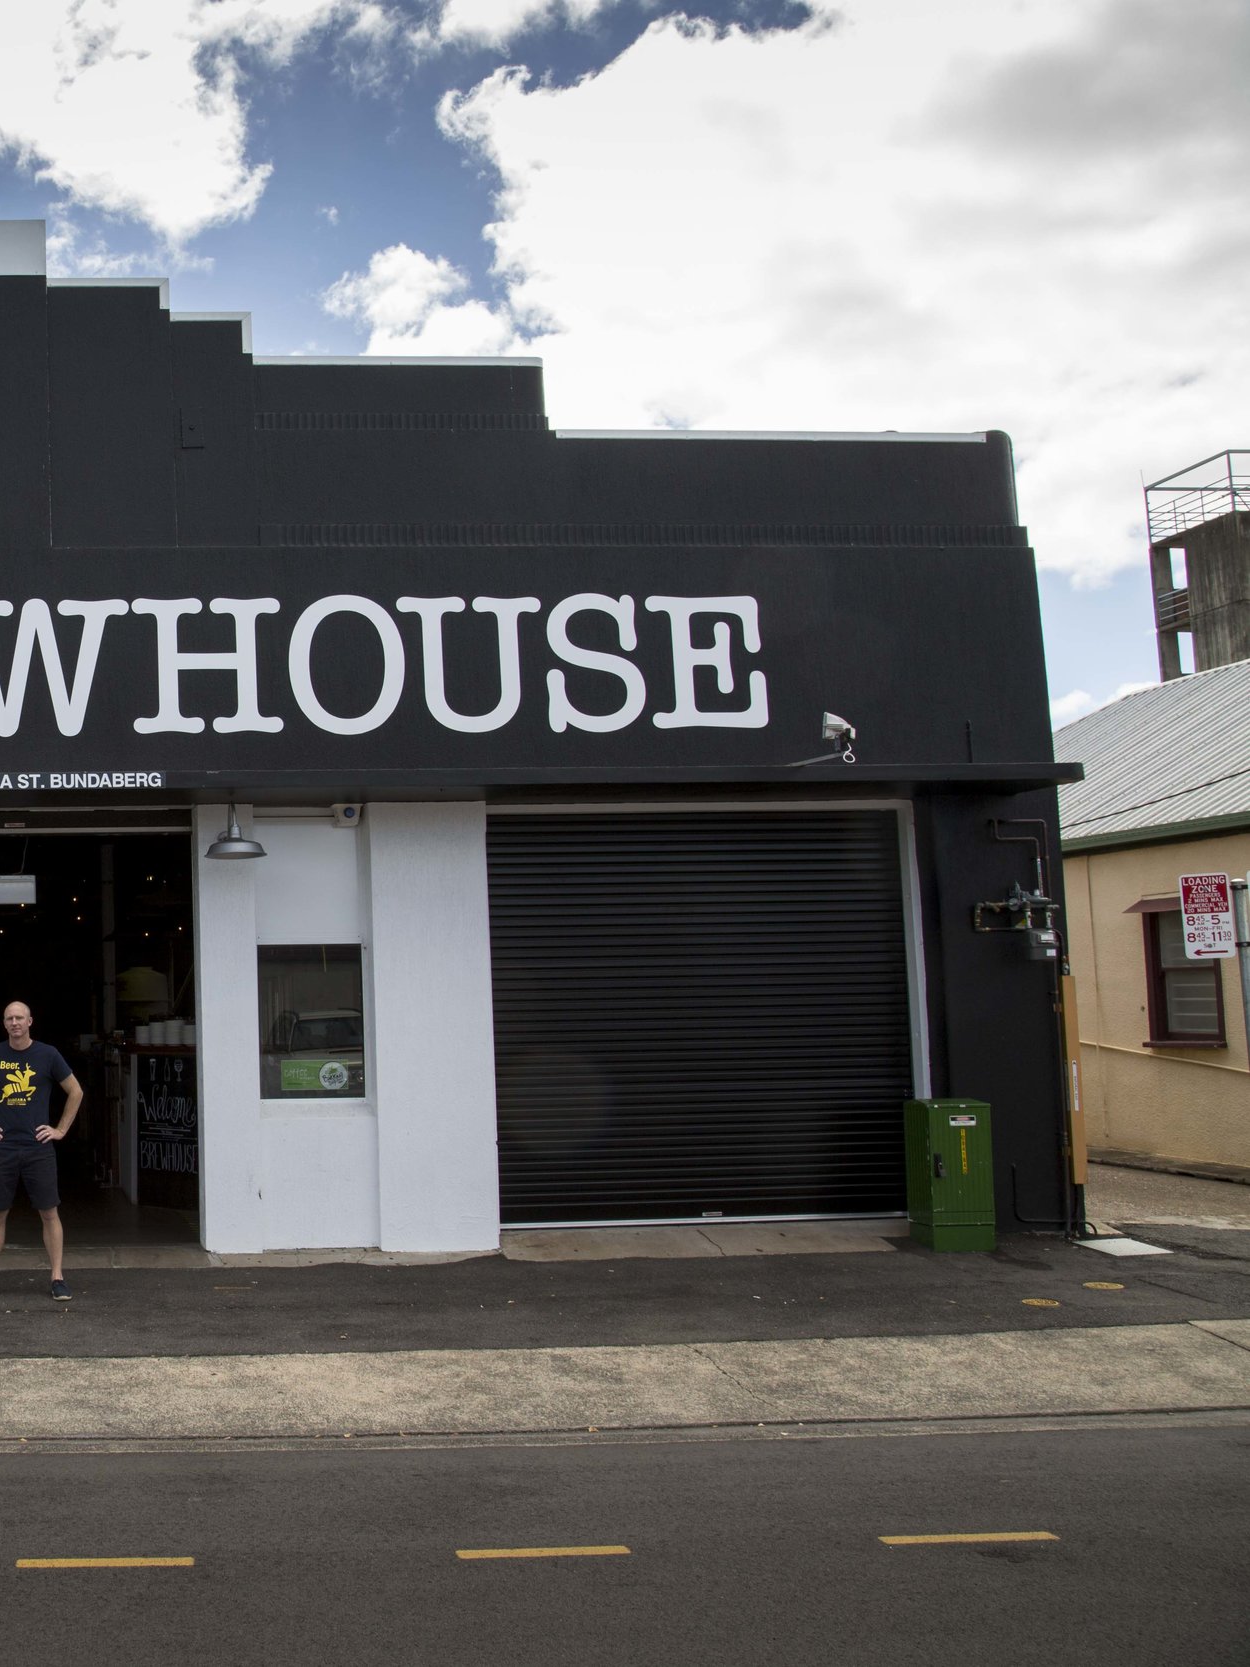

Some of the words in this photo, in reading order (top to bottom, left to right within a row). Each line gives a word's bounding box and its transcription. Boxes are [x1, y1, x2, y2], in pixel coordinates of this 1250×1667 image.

[16, 773, 46, 790] ST.
[49, 771, 163, 790] BUNDABERG
[1182, 876, 1226, 885] LOADING
[1191, 885, 1218, 894] ZONE
[0, 1060, 20, 1070] Beer.
